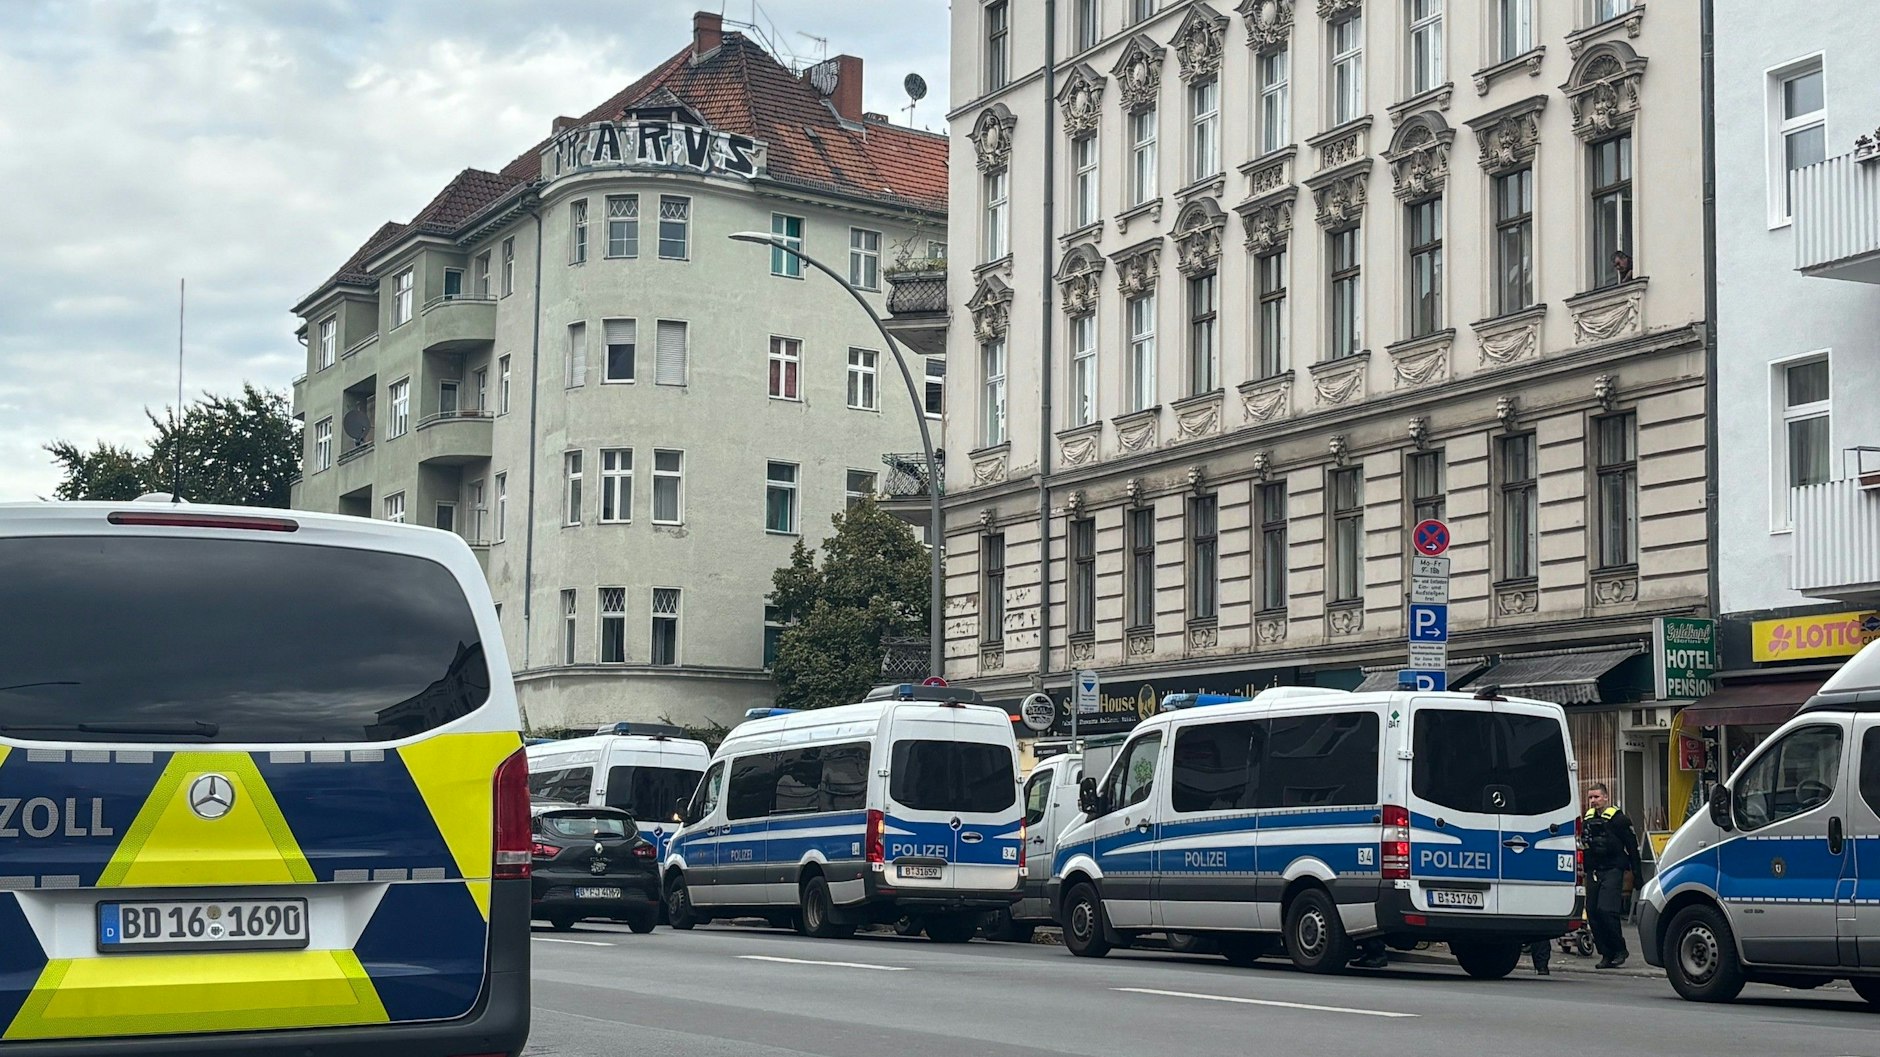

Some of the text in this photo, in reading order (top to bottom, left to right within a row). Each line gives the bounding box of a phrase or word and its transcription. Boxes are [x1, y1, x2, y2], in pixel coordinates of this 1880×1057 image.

[1416, 608, 1436, 637] P
[1796, 620, 1862, 649] LOTTO
[1666, 648, 1714, 670] HOTEL
[1686, 670, 1695, 678] &
[1668, 678, 1714, 696] PENSION
[1100, 692, 1136, 713] House
[0, 796, 114, 838] ZOLL
[730, 848, 753, 862] POLIZEI
[892, 843, 948, 858] POLIZEI
[1004, 847, 1016, 858] 34
[1358, 850, 1372, 864] 34
[1184, 851, 1227, 868] POLIZEI
[1420, 850, 1490, 870] POLIZEI
[1558, 856, 1573, 870] 34
[1438, 892, 1478, 904] B 31769
[122, 904, 301, 939] BD 16 1690
